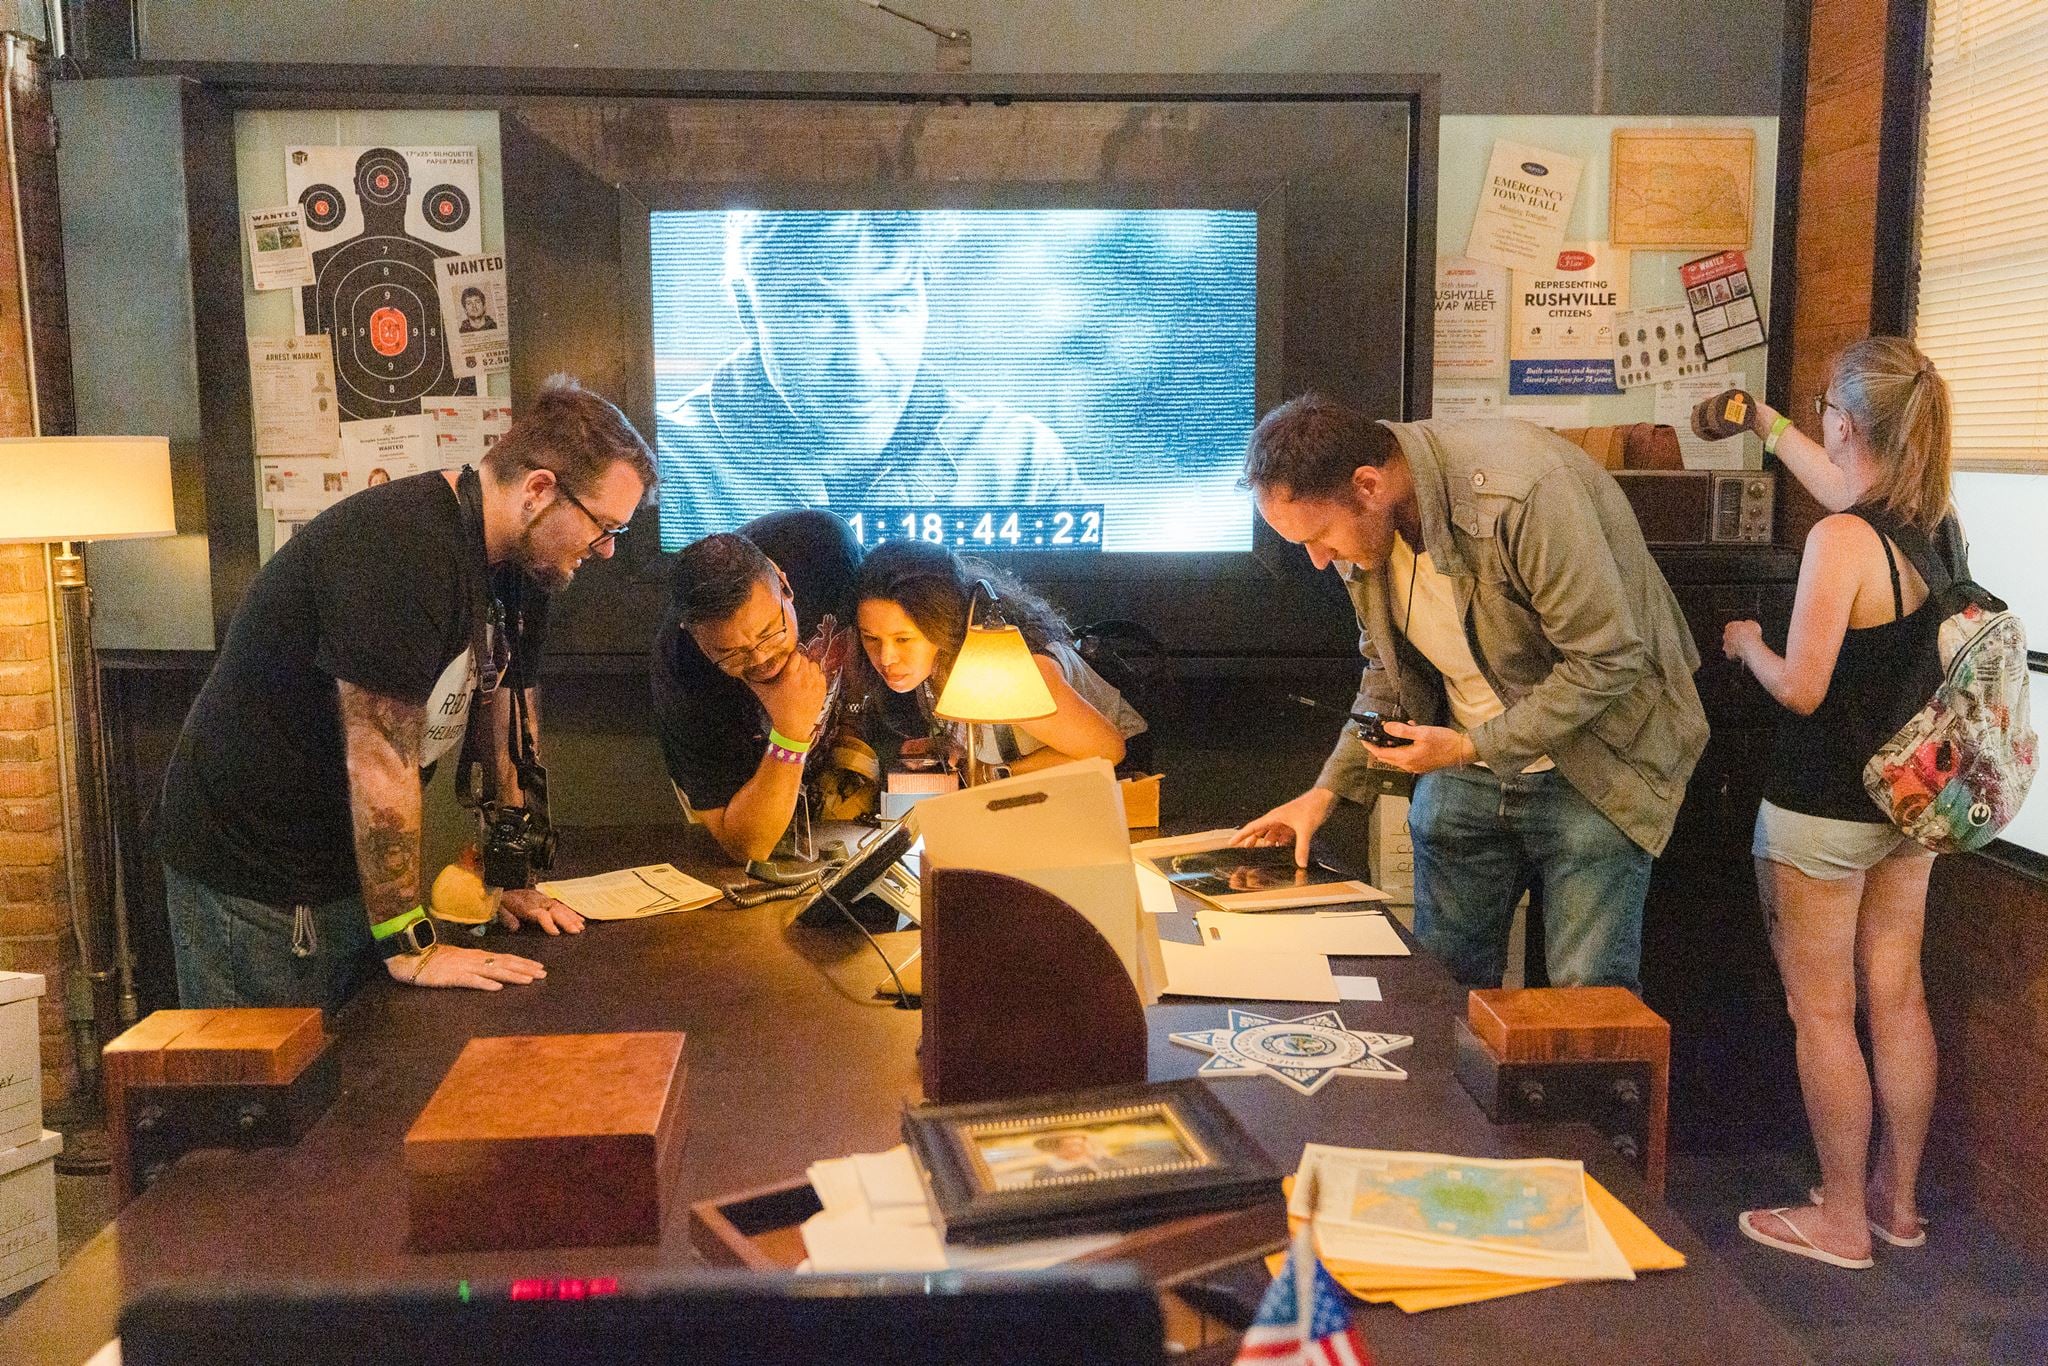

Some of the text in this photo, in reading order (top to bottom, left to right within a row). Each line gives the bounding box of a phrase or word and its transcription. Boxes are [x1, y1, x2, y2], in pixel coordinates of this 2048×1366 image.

[1493, 176, 1565, 201] EMERGENCY
[1493, 187, 1559, 213] TOWN HALL
[252, 211, 298, 221] WANTED
[382, 246, 388, 255] 7
[446, 256, 503, 276] WANTED
[383, 267, 390, 276] 8
[1534, 280, 1608, 289] REPRESENTING
[384, 291, 391, 300] 9
[1435, 289, 1495, 300] USHVILLE
[1525, 293, 1617, 307] RUSHVILLE
[1434, 301, 1497, 311] WAP MEET
[1548, 309, 1593, 318] CITIZENS
[341, 327, 348, 336] 8
[359, 327, 365, 336] 9
[412, 327, 419, 336] 9
[430, 327, 436, 336] 8
[266, 352, 322, 361] ARREST WARRANT
[388, 362, 394, 371] 9
[1572, 376, 1584, 384] for
[389, 385, 395, 393] 8
[378, 444, 404, 452] WANTED
[438, 692, 467, 715] RED
